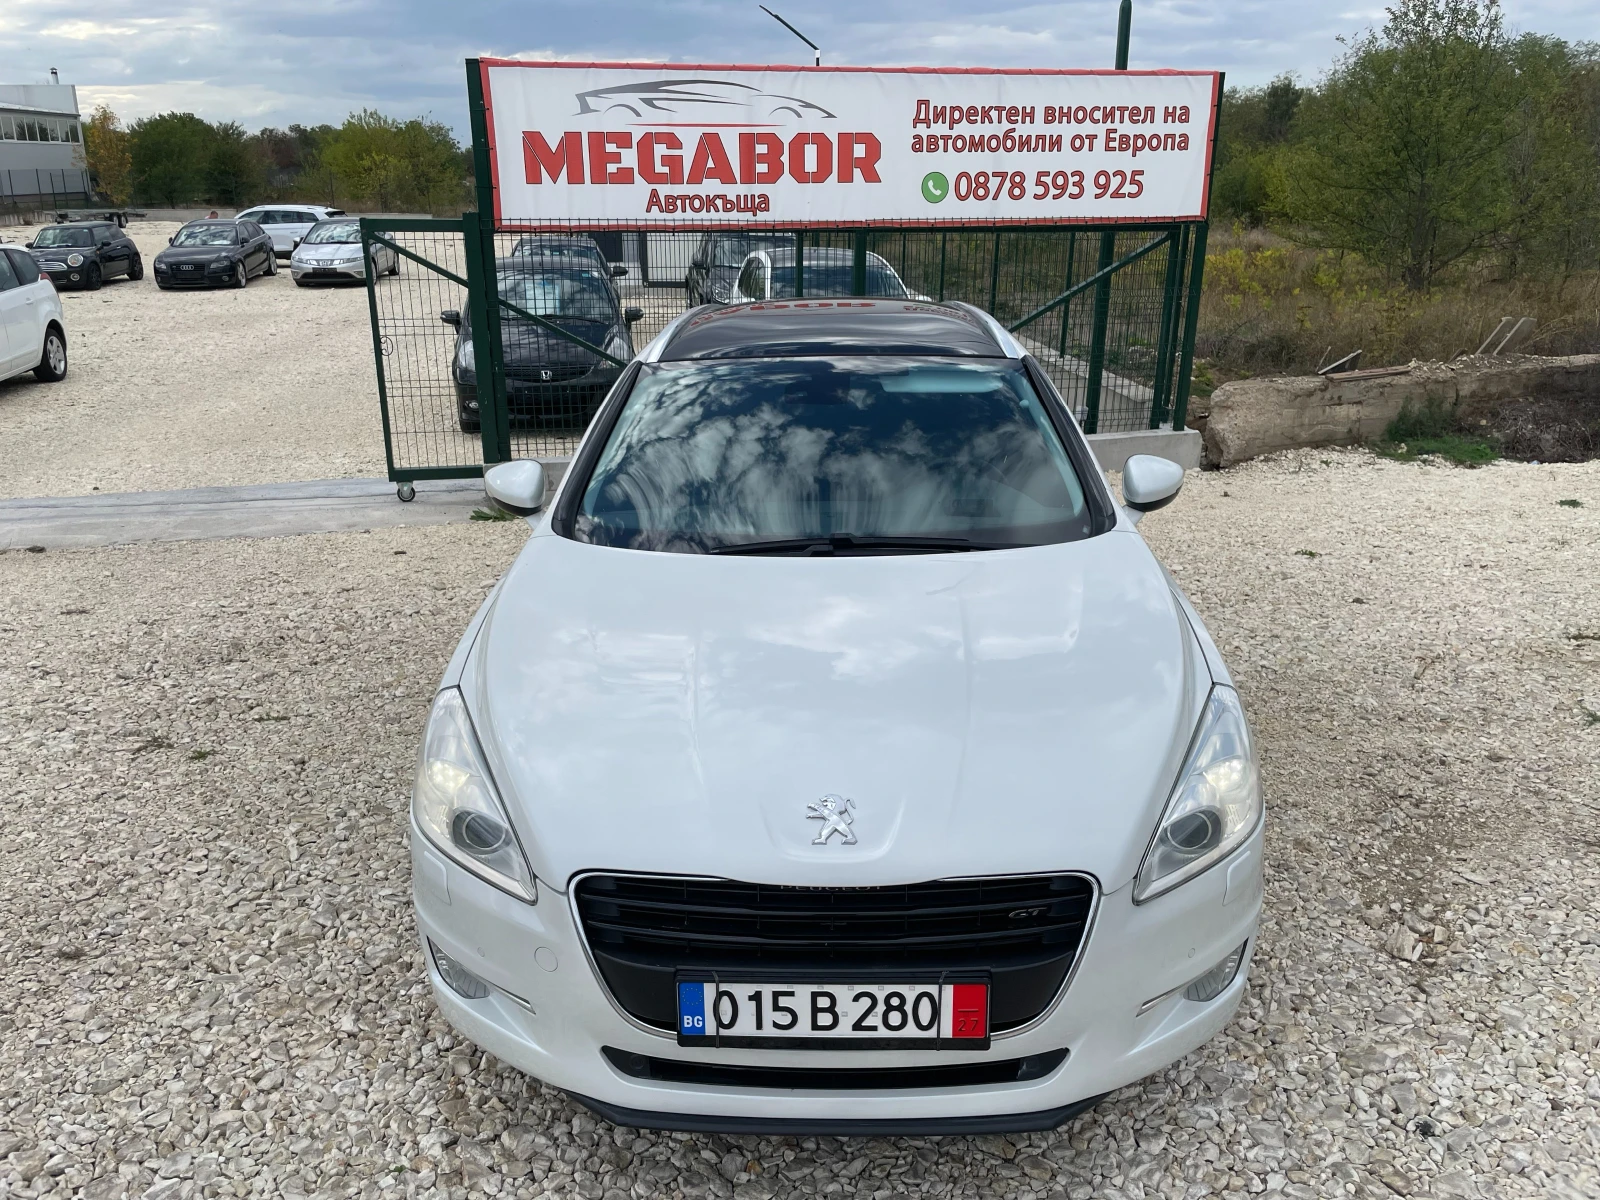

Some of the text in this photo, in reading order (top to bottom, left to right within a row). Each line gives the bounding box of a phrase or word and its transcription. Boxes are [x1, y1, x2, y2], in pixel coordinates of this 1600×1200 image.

[912, 99, 1190, 130] Директен вносител на
[911, 128, 1190, 157] автомобили от Европа
[522, 132, 882, 184] MEGABOR
[955, 170, 1145, 201] 0878 593 925
[646, 189, 770, 217] Автокъща
[683, 1015, 703, 1028] BG
[957, 1018, 977, 1032] 27
